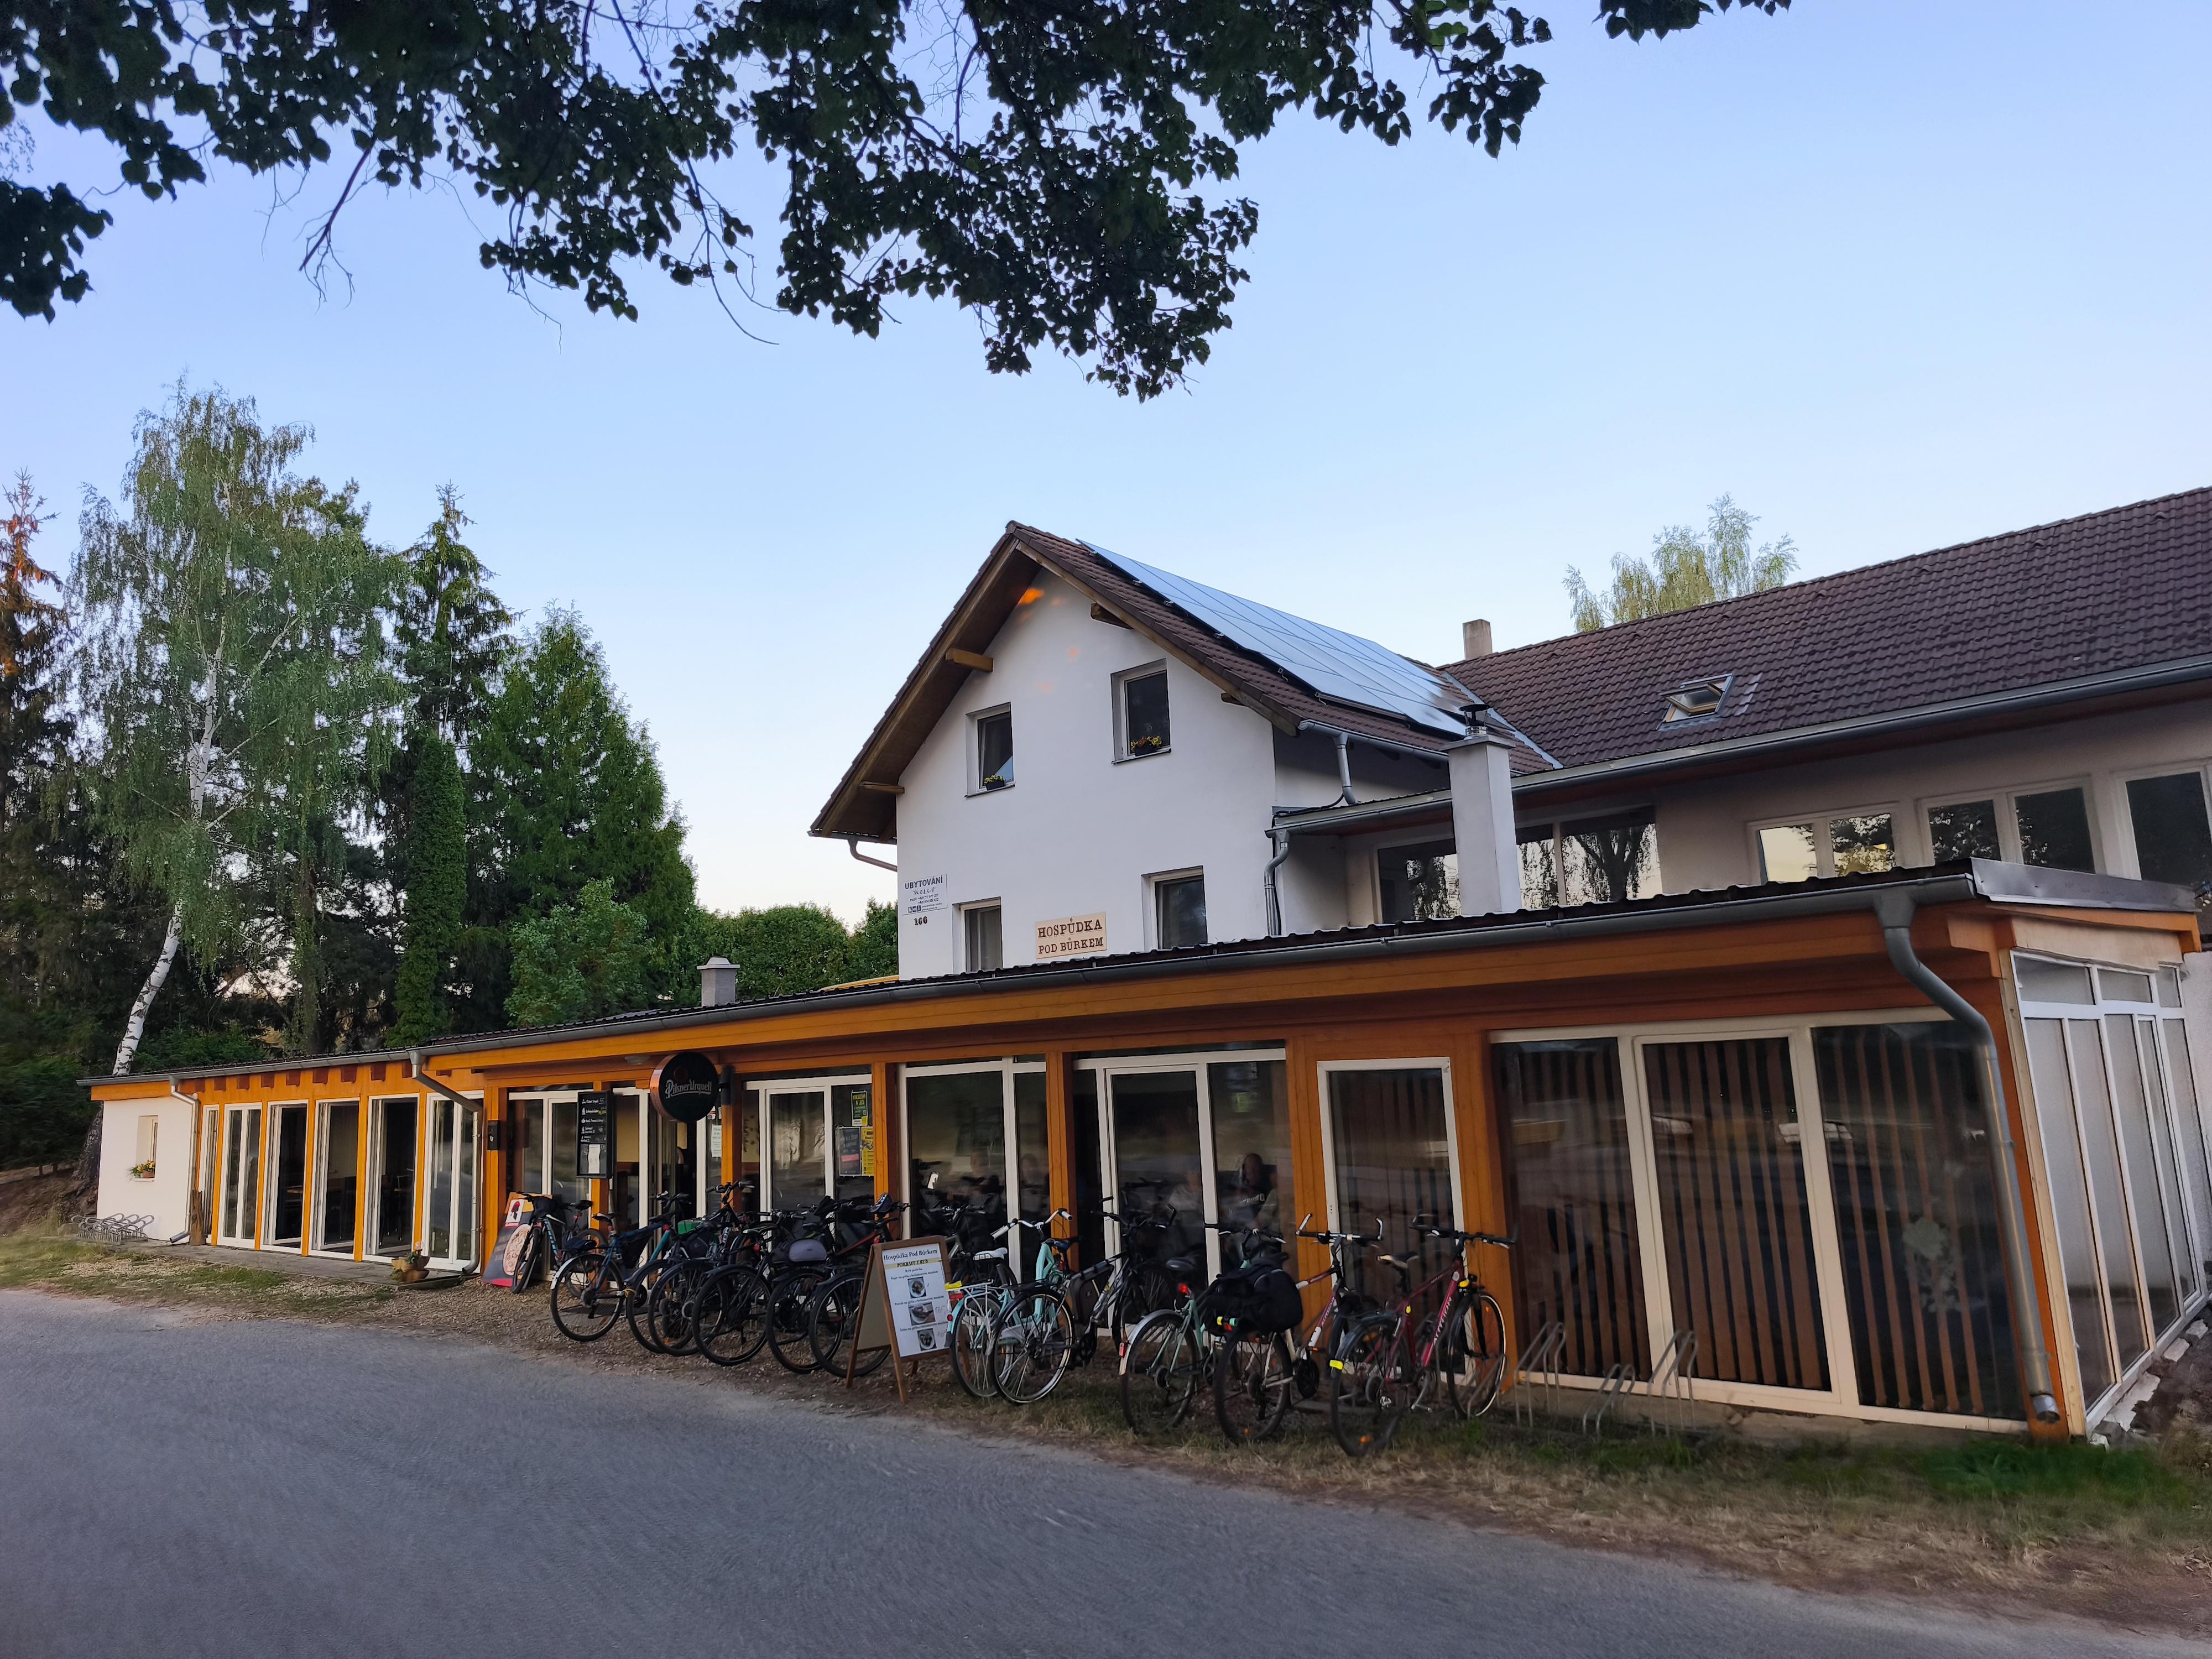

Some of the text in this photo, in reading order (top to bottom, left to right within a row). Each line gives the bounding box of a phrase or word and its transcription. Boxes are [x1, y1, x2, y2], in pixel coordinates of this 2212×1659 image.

[905, 875, 942, 889] UBYTOVÁNÍ
[1037, 917, 1103, 938] HOSPŮDKA
[1039, 937, 1103, 954] POD BŮRKEM
[665, 1079, 712, 1099] Pilsner Urquell
